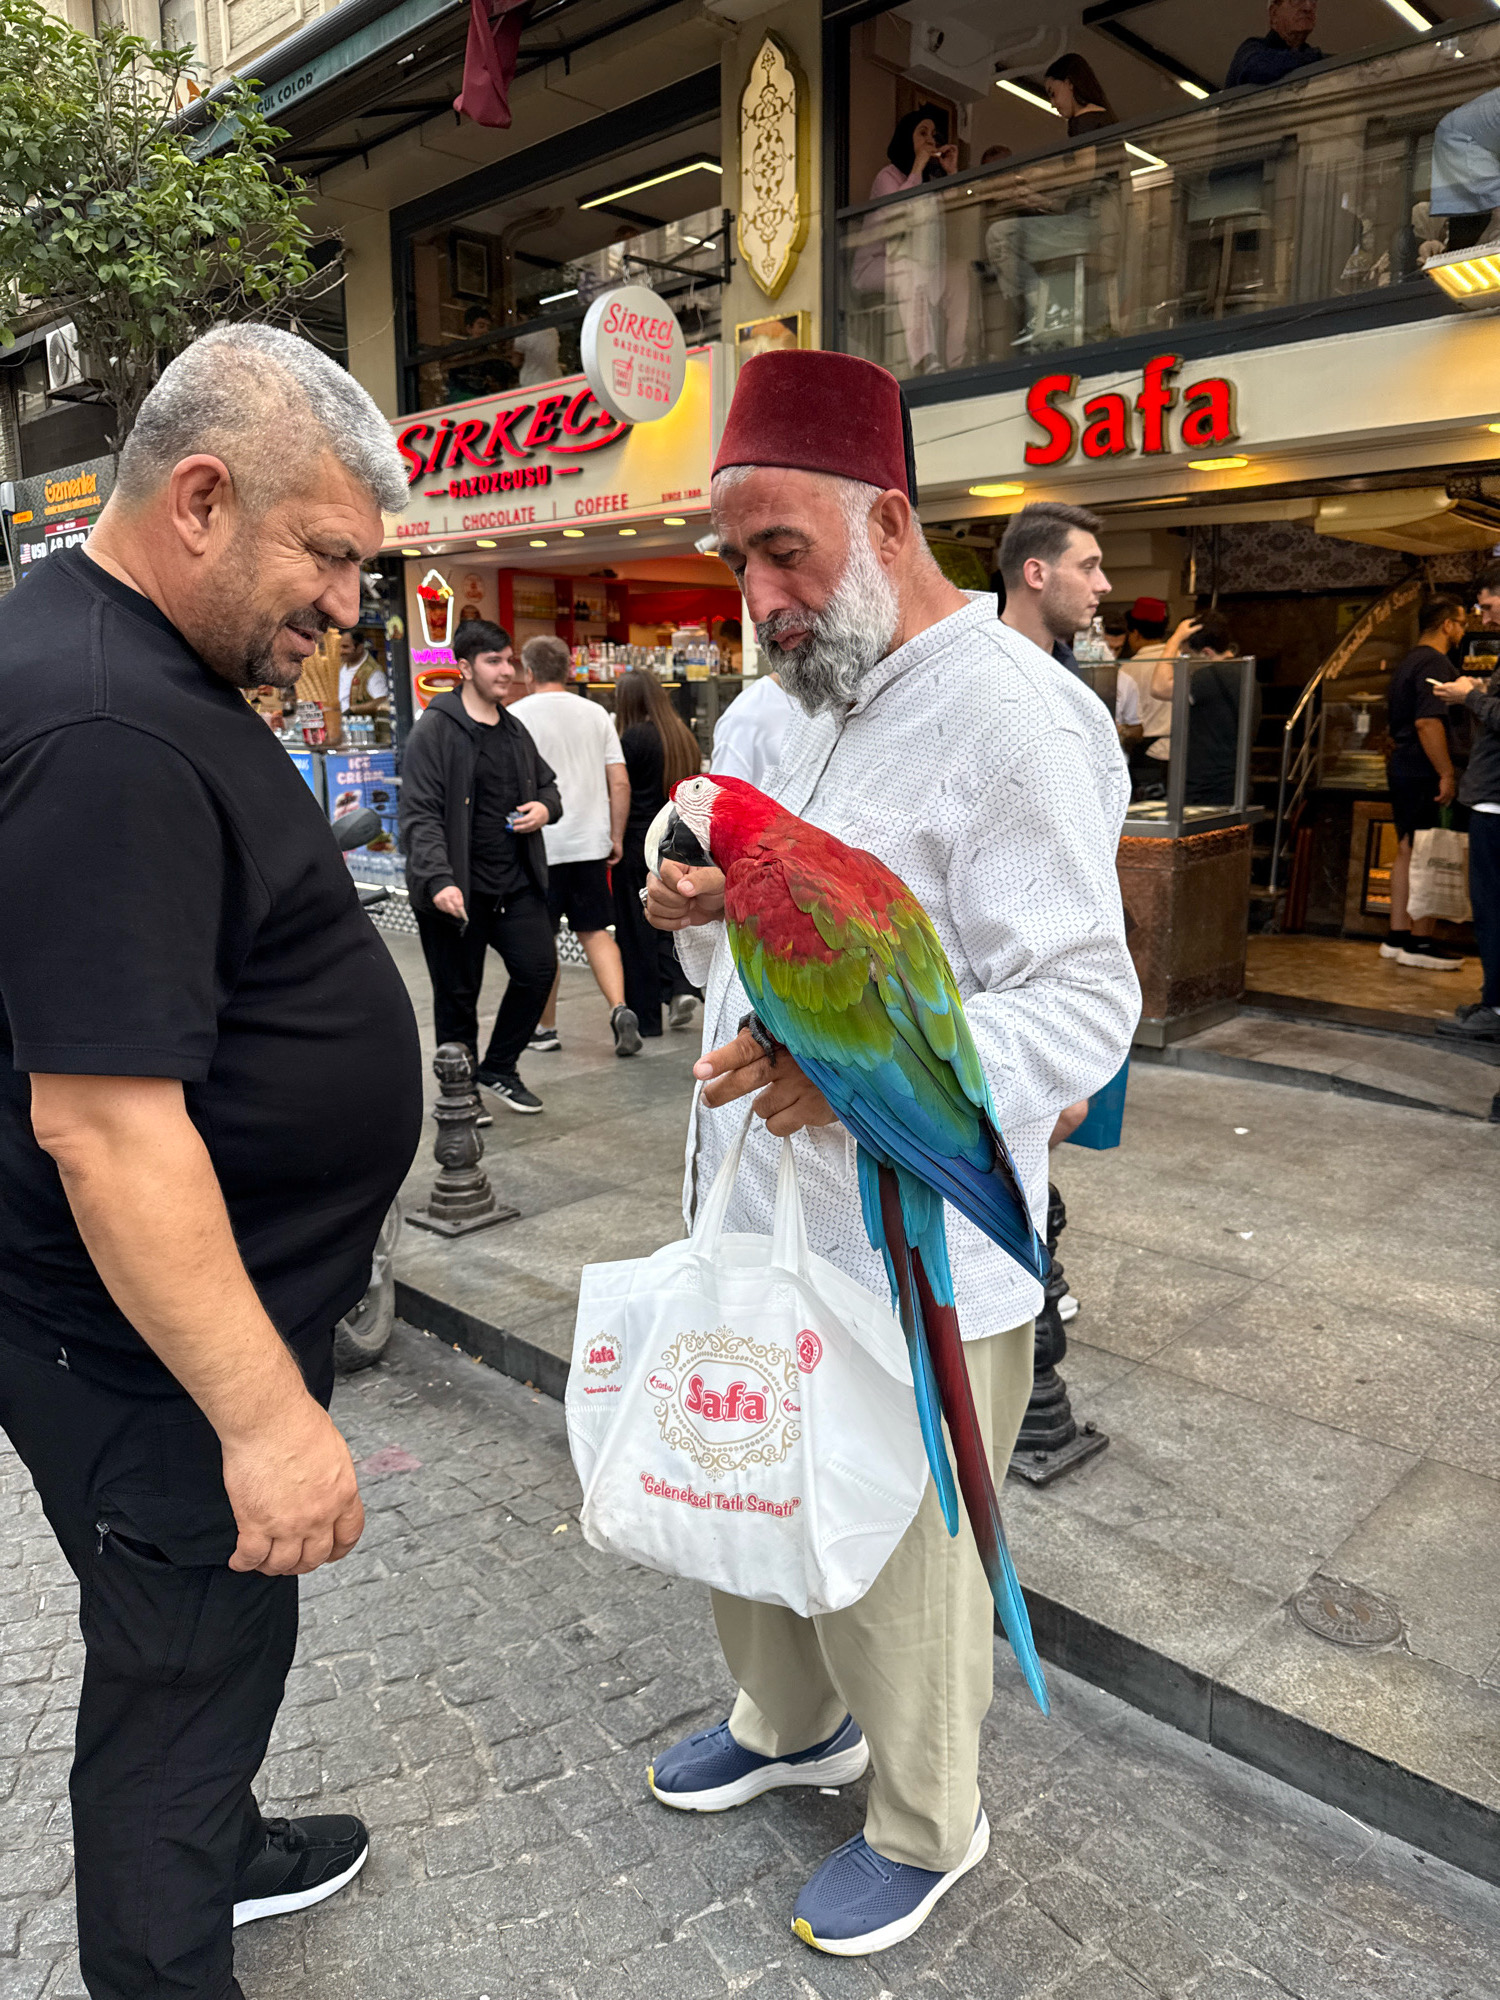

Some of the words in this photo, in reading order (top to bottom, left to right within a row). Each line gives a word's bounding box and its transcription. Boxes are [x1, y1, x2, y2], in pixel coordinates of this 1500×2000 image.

[257, 94, 275, 113] GÜL
[278, 72, 313, 103] COLOR
[613, 337, 671, 365] GAZOZCUSU
[637, 383, 670, 405] SODA
[1024, 354, 1236, 466] Safa
[397, 387, 627, 484] SİRKEC
[448, 464, 549, 499] GAZOZCUSU
[396, 521, 430, 539] GAZOZ
[462, 506, 536, 531] CHOCOLATE
[574, 493, 628, 517] COFFEE
[31, 542, 47, 560] USD
[411, 648, 458, 665] WAFFL
[713, 1494, 743, 1512] Tatlı
